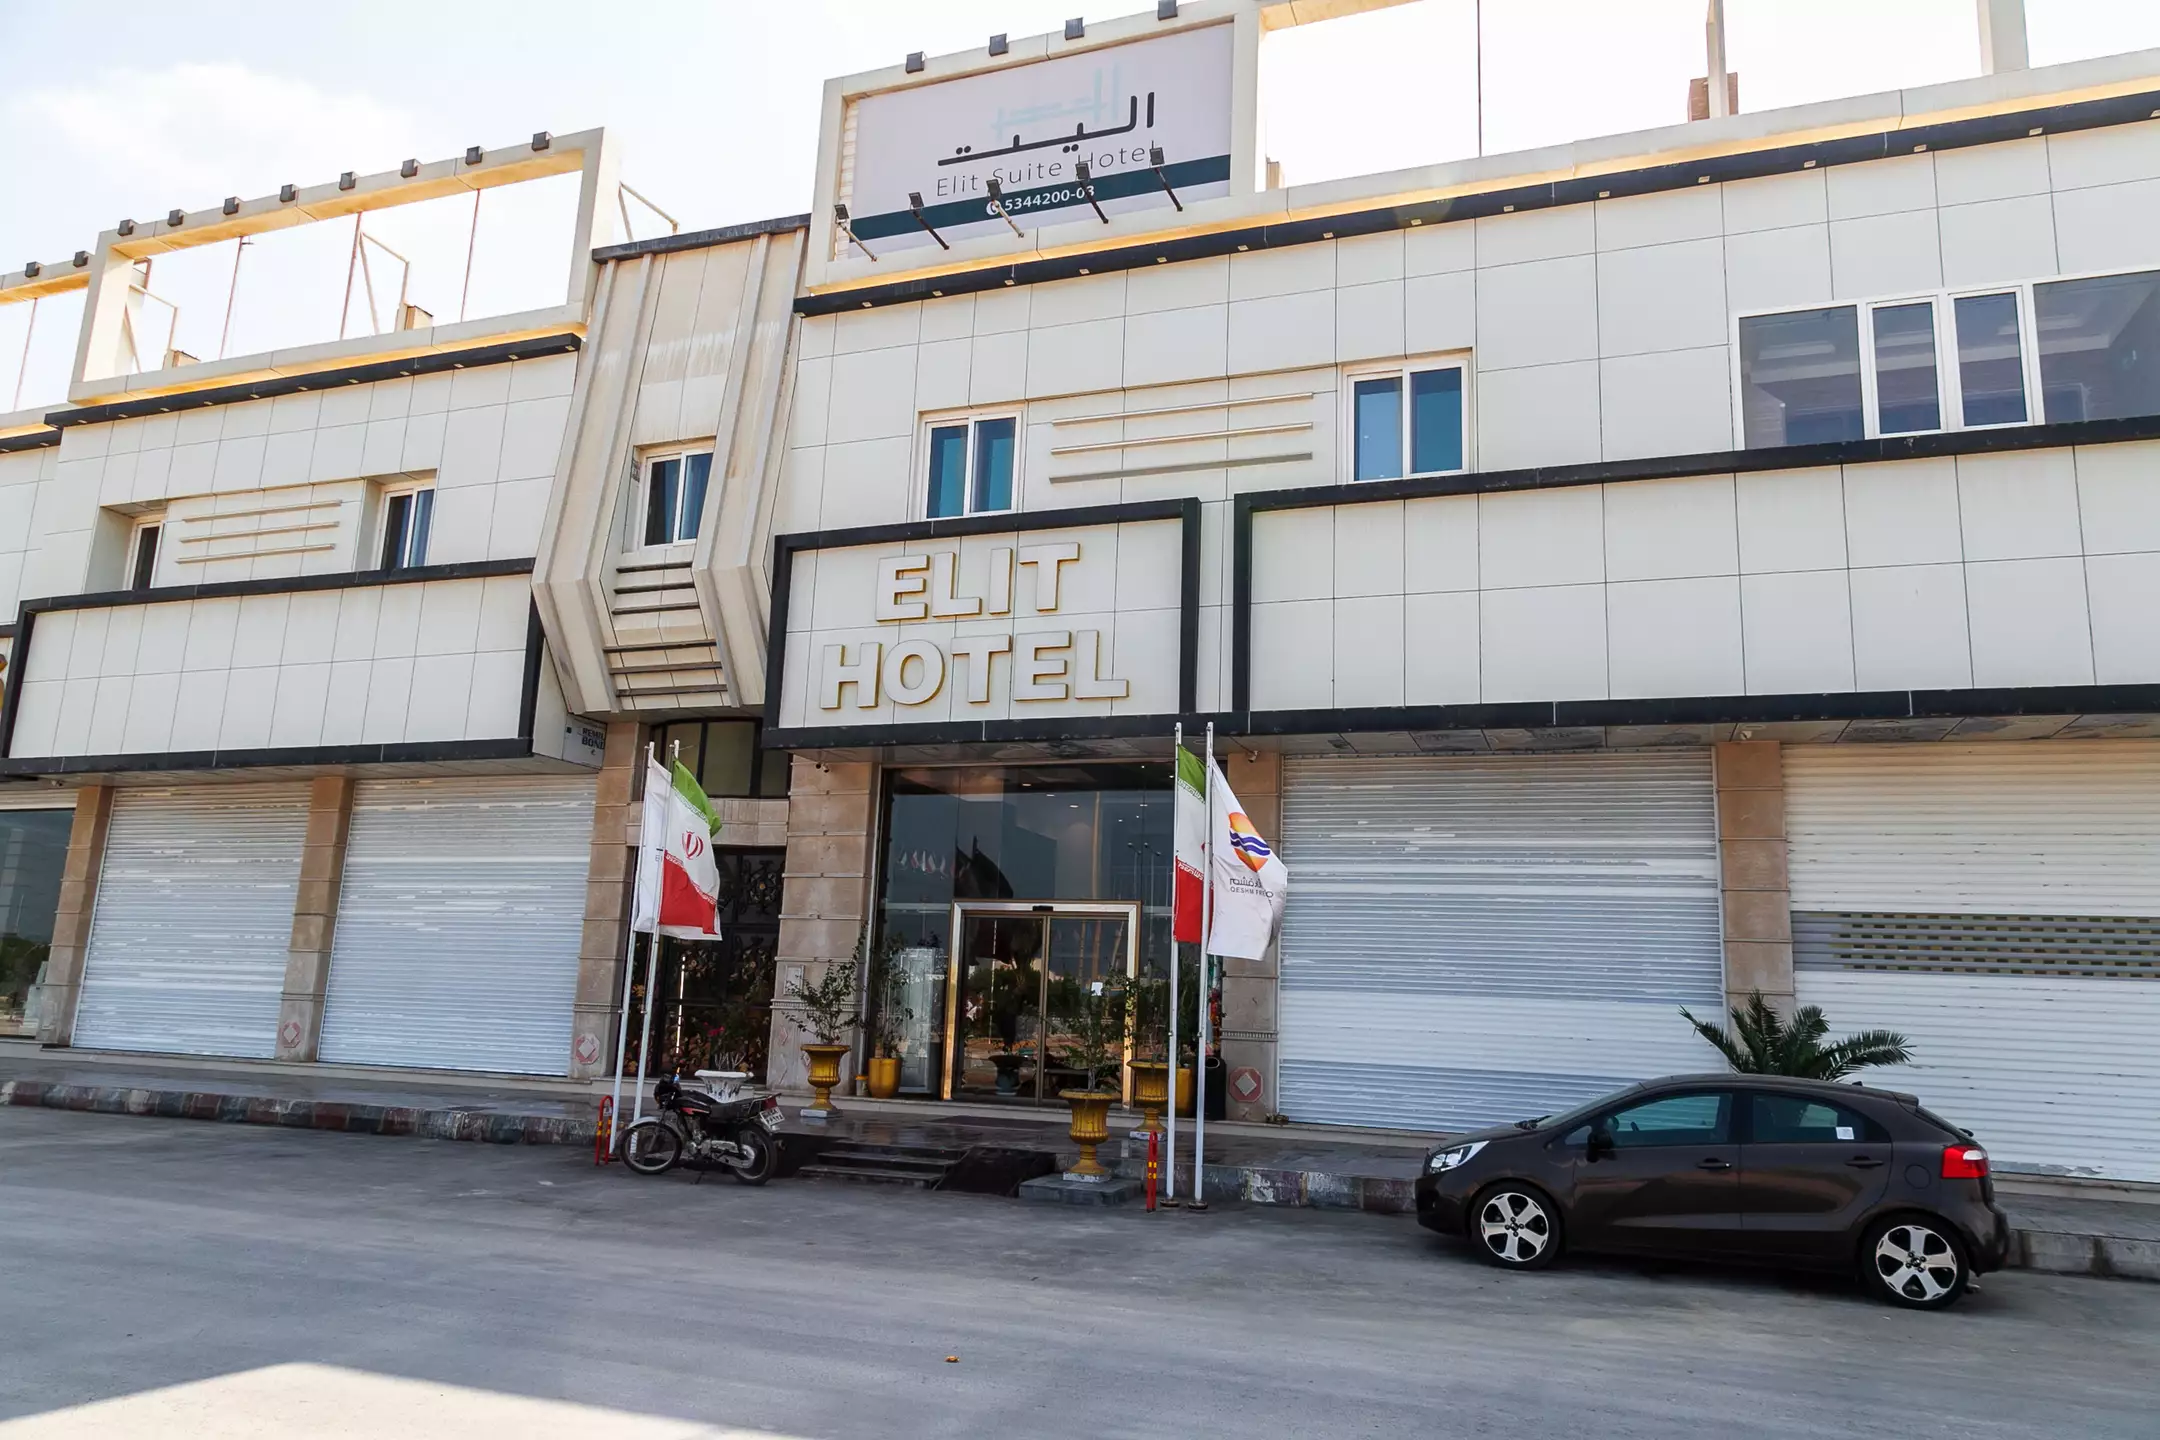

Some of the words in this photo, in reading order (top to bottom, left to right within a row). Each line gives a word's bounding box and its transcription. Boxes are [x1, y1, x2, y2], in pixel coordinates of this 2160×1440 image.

[937, 175, 978, 196] Elit
[993, 162, 1062, 186] Suite
[876, 542, 1080, 621] ELIT
[820, 630, 1129, 709] HOTEL
